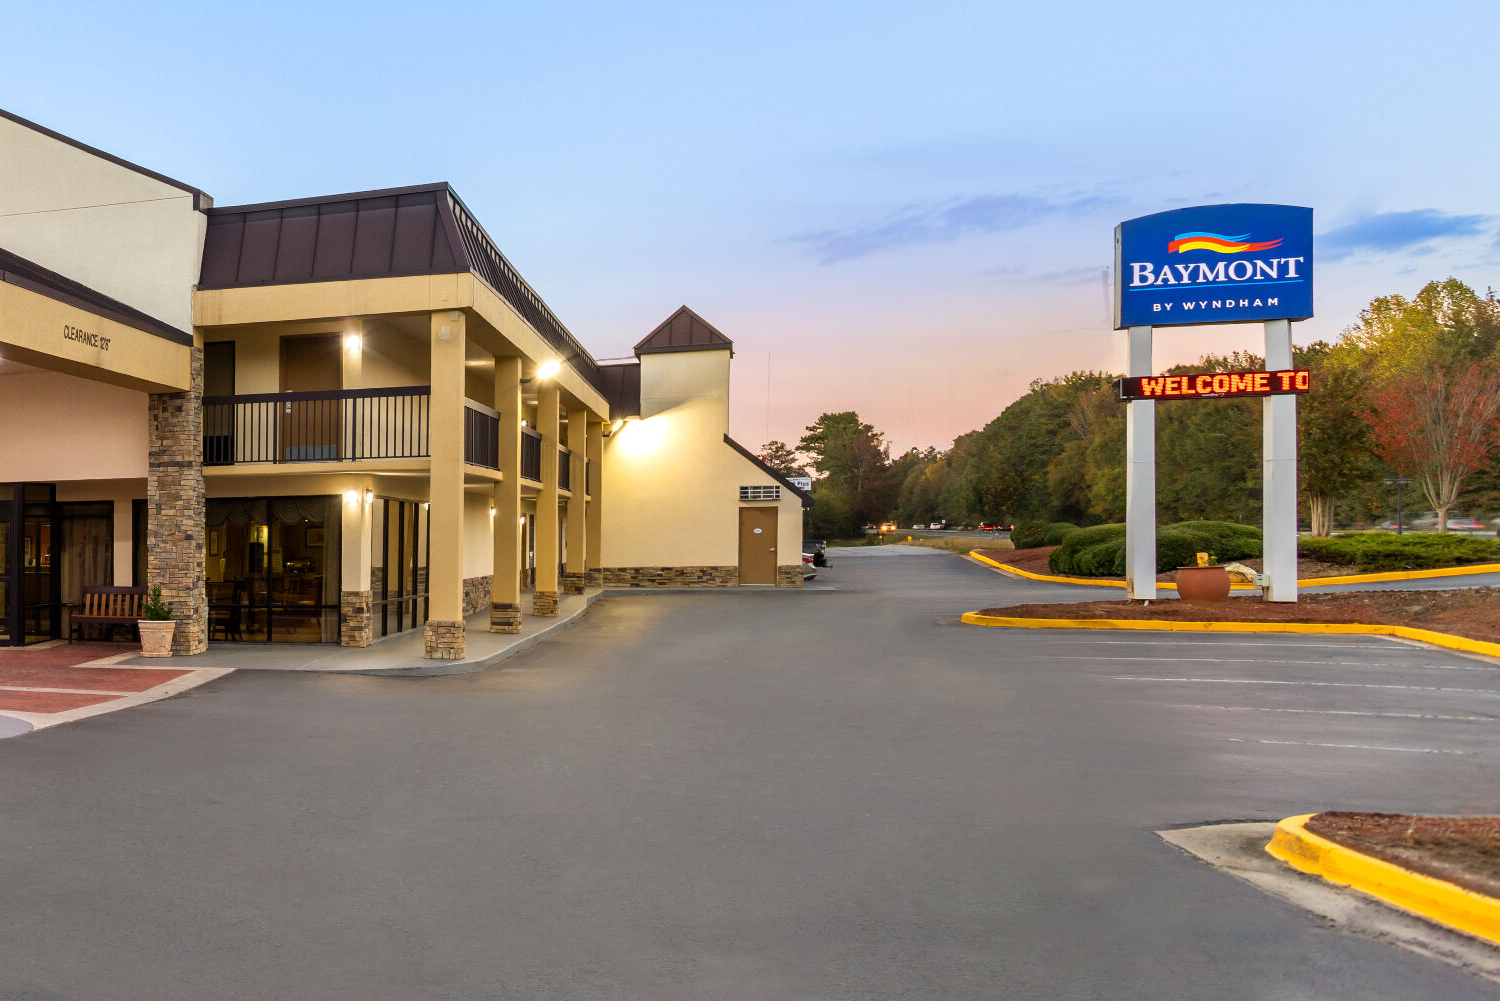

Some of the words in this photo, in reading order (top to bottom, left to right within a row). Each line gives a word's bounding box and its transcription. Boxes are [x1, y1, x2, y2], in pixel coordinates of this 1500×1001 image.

[1129, 256, 1304, 287] BAYMONT
[1153, 303, 1173, 312] BY
[1182, 298, 1279, 311] WYNDHAM
[63, 324, 99, 348] CLEARANCE
[1141, 373, 1271, 396] WELCOME
[1276, 371, 1309, 391] TO
